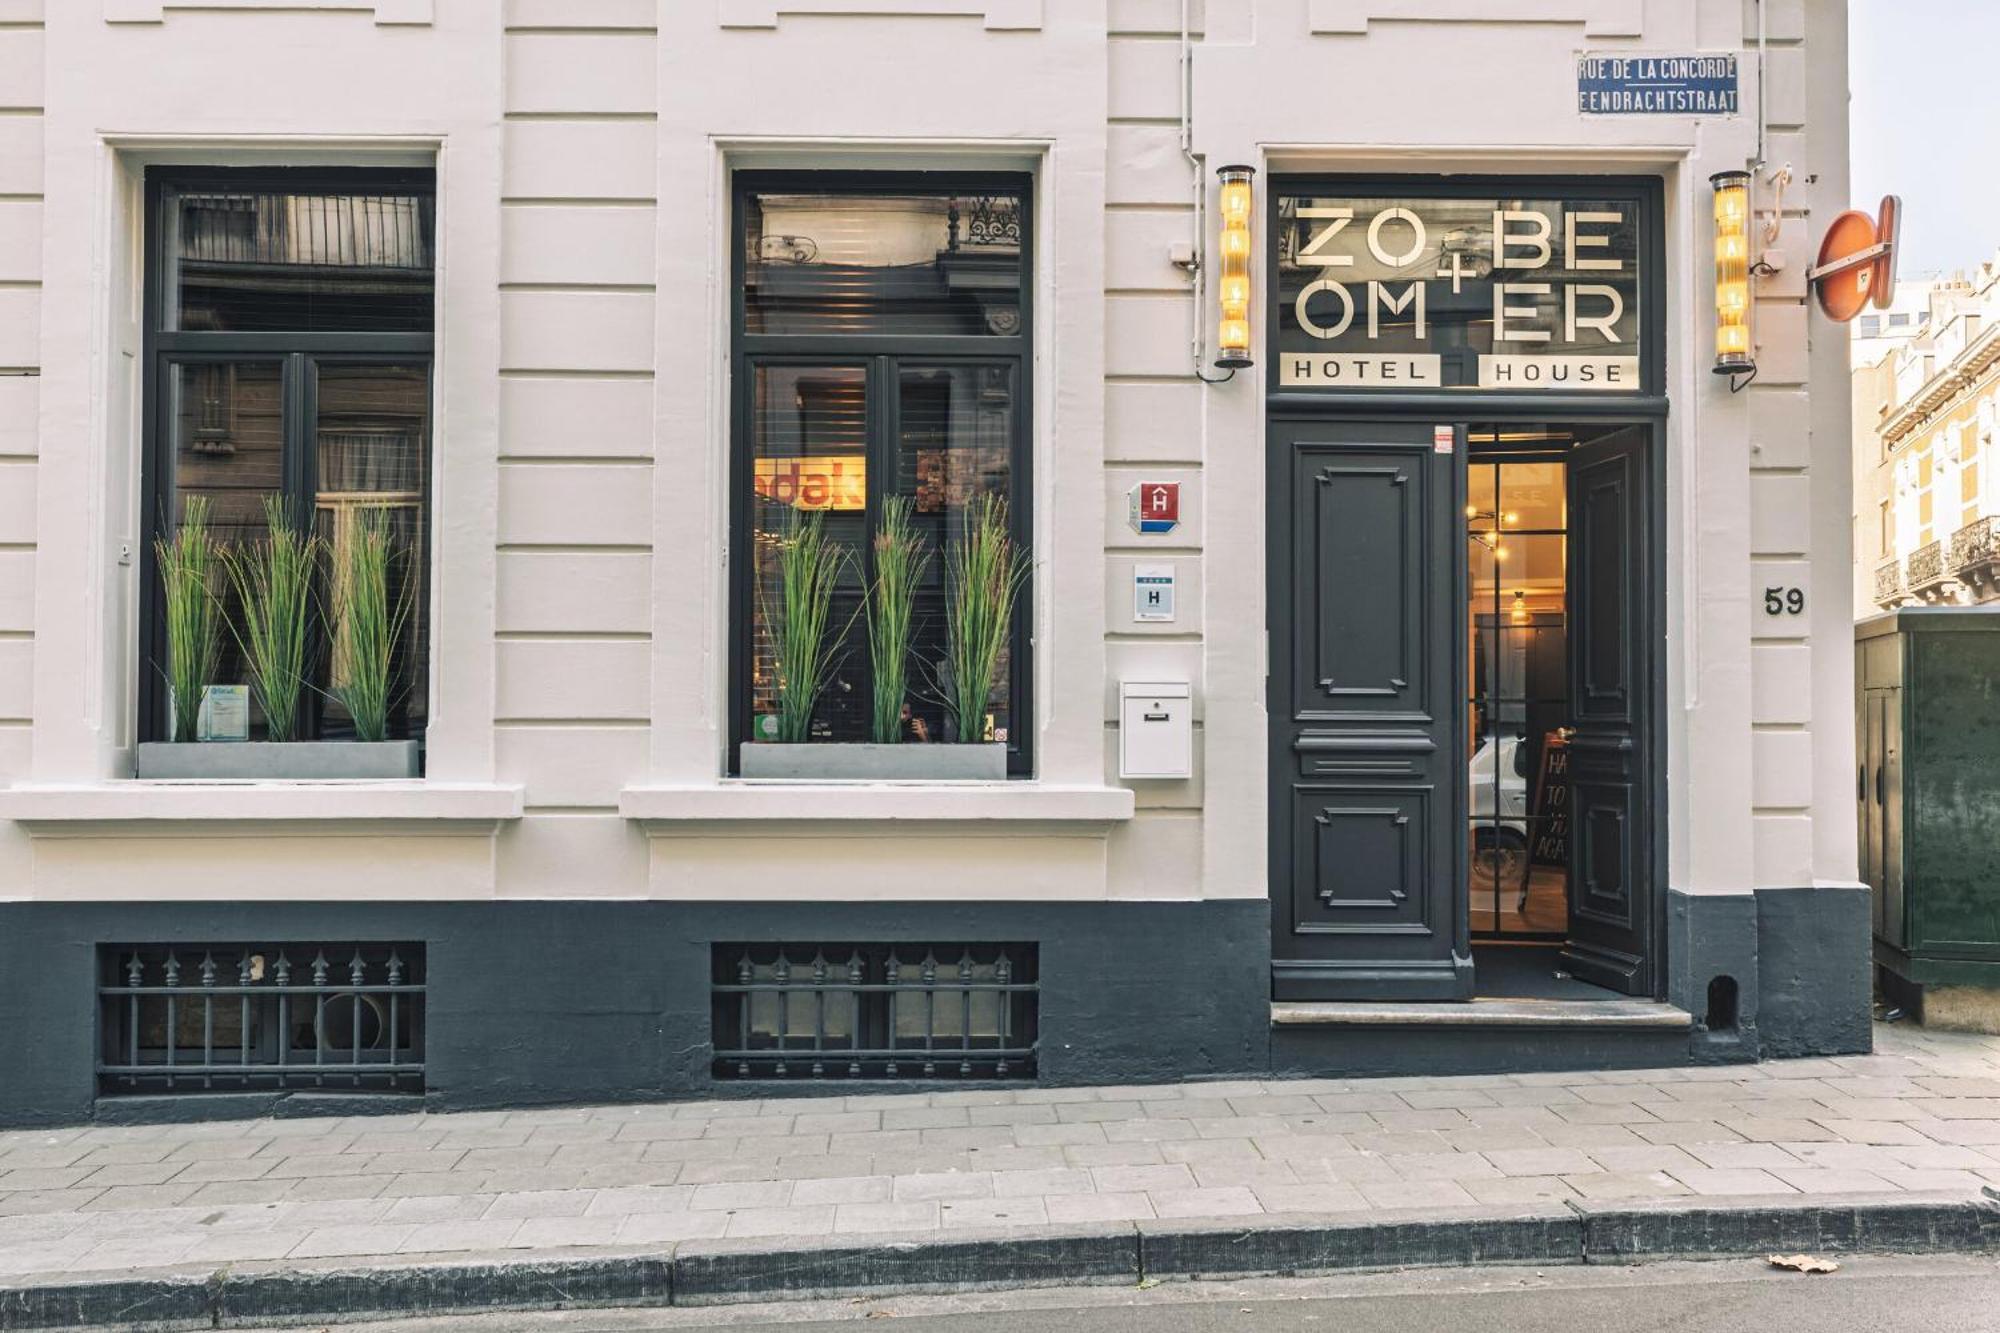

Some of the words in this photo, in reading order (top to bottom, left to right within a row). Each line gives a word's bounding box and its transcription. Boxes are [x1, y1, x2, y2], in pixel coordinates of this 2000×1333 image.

[1578, 59, 1607, 79] RUE
[1613, 59, 1631, 79] DE
[1638, 59, 1656, 79] LA
[1661, 58, 1735, 79] CONCORDE
[1579, 90, 1736, 111] EENDRACHTSTRAAT
[1295, 207, 1427, 268] ZO
[1493, 210, 1623, 270] BE
[1295, 279, 1427, 340] OM
[1493, 283, 1624, 343] ER
[1295, 360, 1426, 380] HOTEL
[1495, 363, 1622, 382] HOUSE
[1148, 591, 1160, 604] H
[1765, 586, 1804, 615] 59
